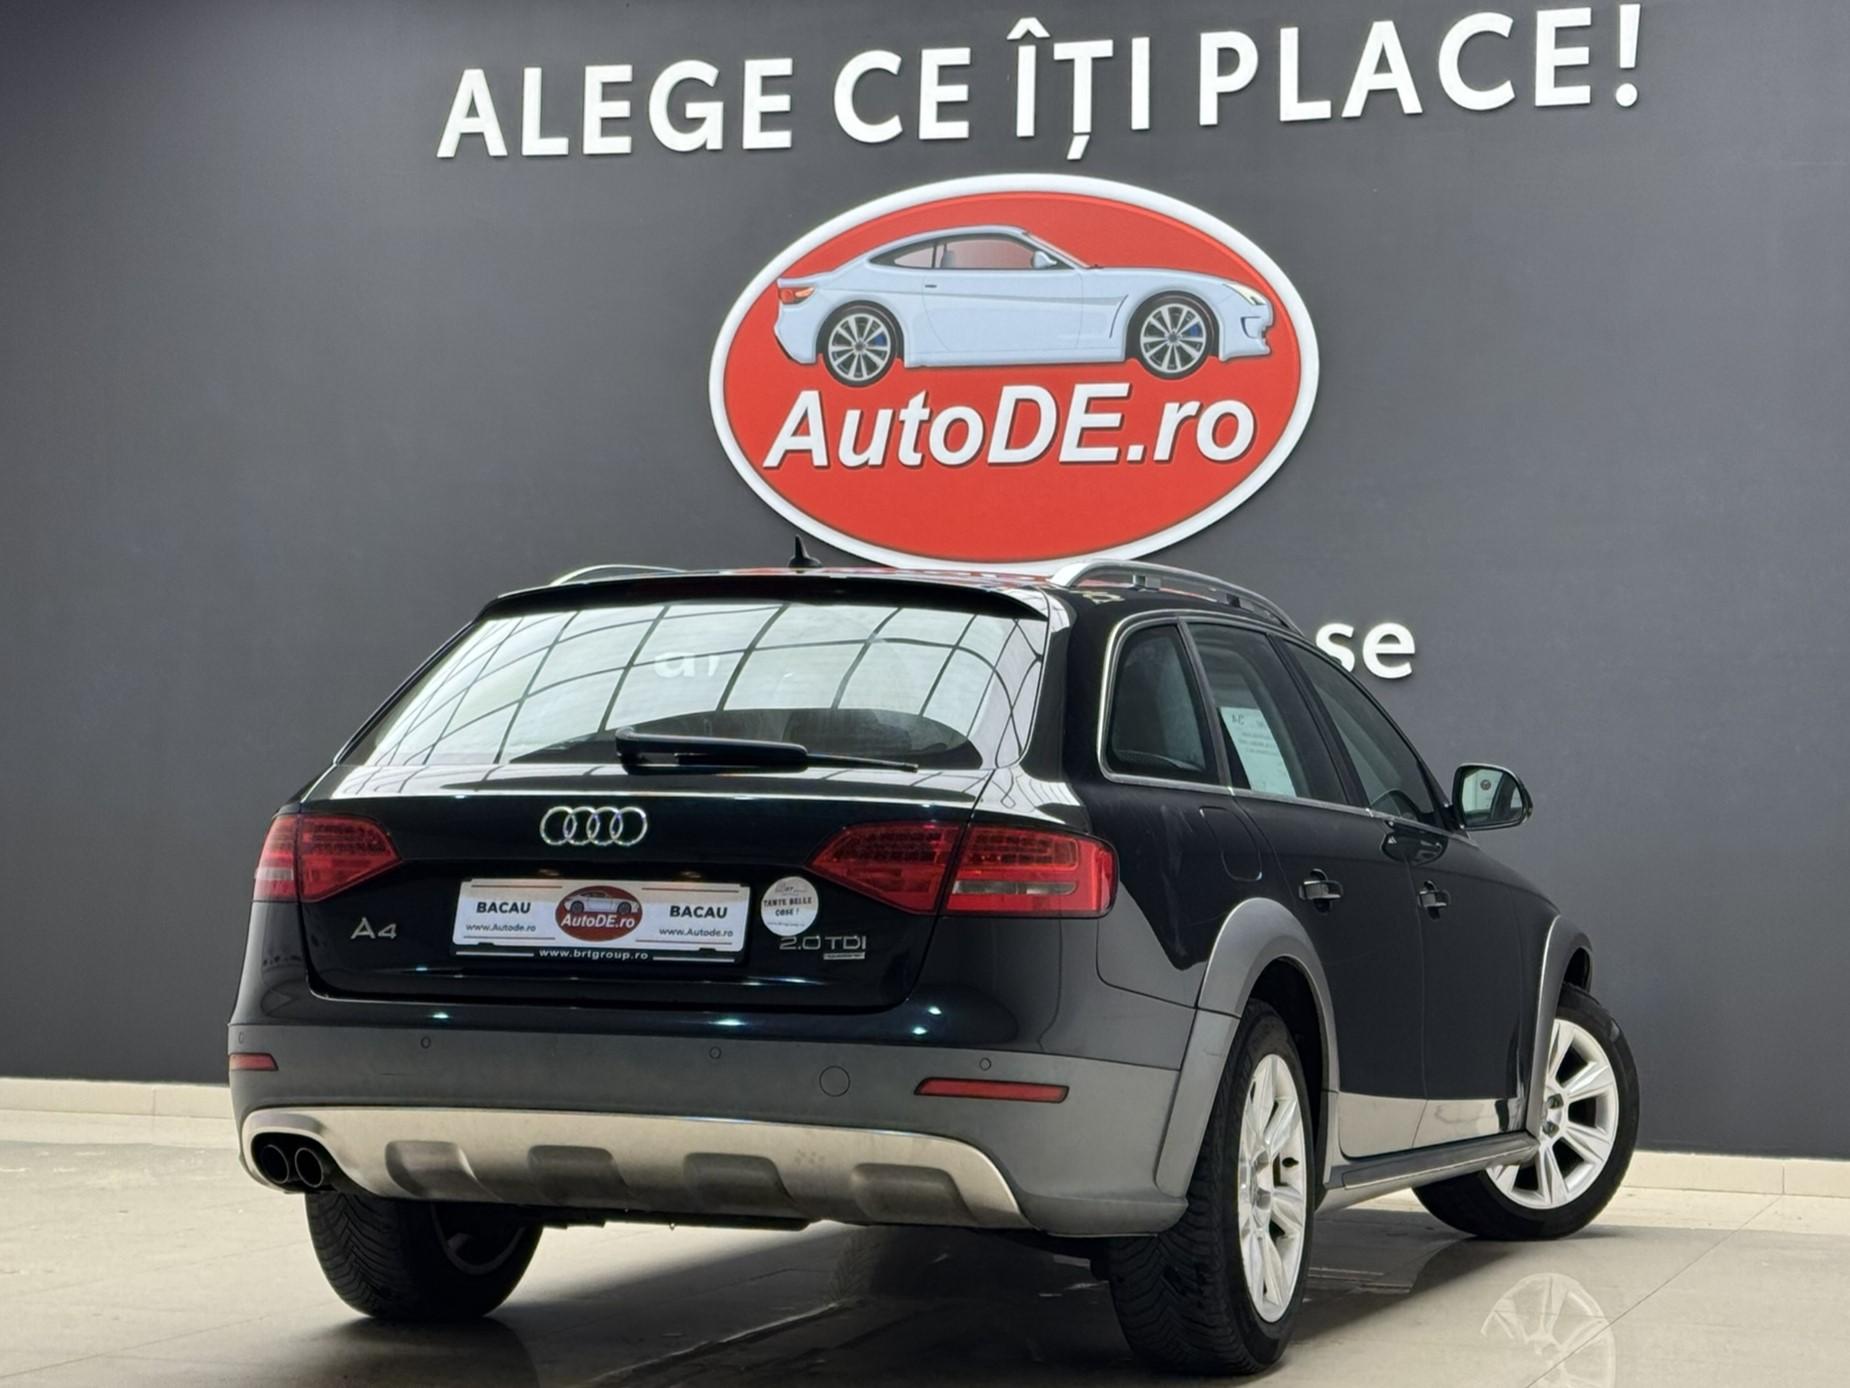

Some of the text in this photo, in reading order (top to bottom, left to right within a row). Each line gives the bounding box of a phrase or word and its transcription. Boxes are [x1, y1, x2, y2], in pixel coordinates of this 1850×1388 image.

[436, 58, 794, 159] ALEGE
[833, 48, 972, 144] CE
[1199, 4, 1641, 126] PLACE!
[762, 383, 1257, 468] AutoDE.ro
[476, 901, 532, 914] BACAU
[669, 905, 729, 919] BACAU
[350, 916, 397, 940] A4
[465, 923, 537, 933] www.Autode.ro
[560, 914, 636, 928] AutoDE.ro
[659, 928, 734, 937] www.Autode.ro
[779, 934, 867, 950] 2.0 TDI
[539, 949, 649, 961] www.brtgroup.ro
